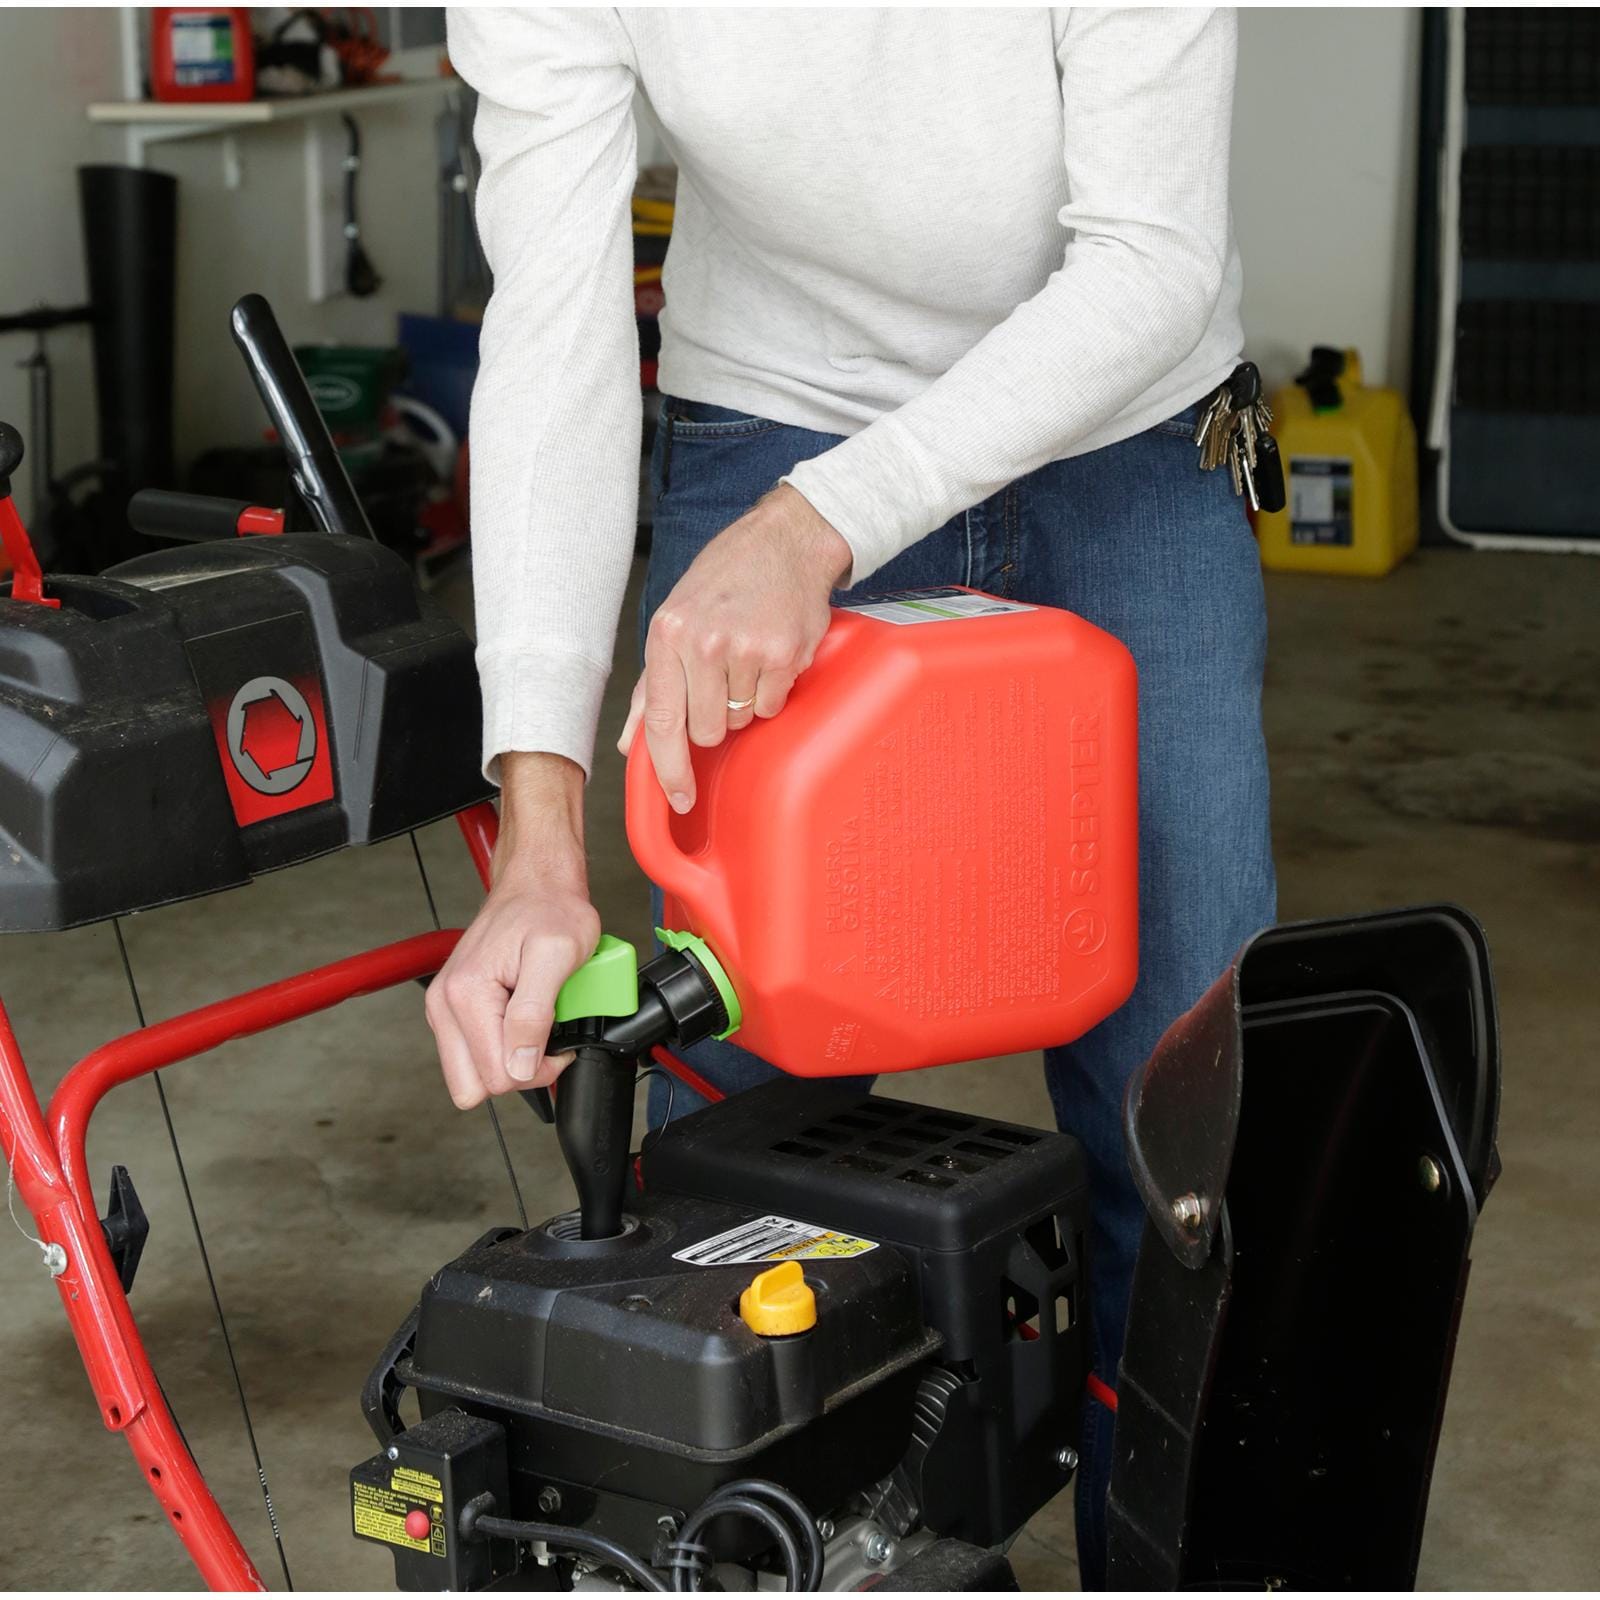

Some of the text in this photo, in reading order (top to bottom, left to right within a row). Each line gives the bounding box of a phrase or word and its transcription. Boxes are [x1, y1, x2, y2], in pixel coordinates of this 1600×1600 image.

[1070, 712, 1100, 896] SCEPTER
[824, 839, 842, 934] PELIGRO
[842, 814, 860, 931] GASOLINA
